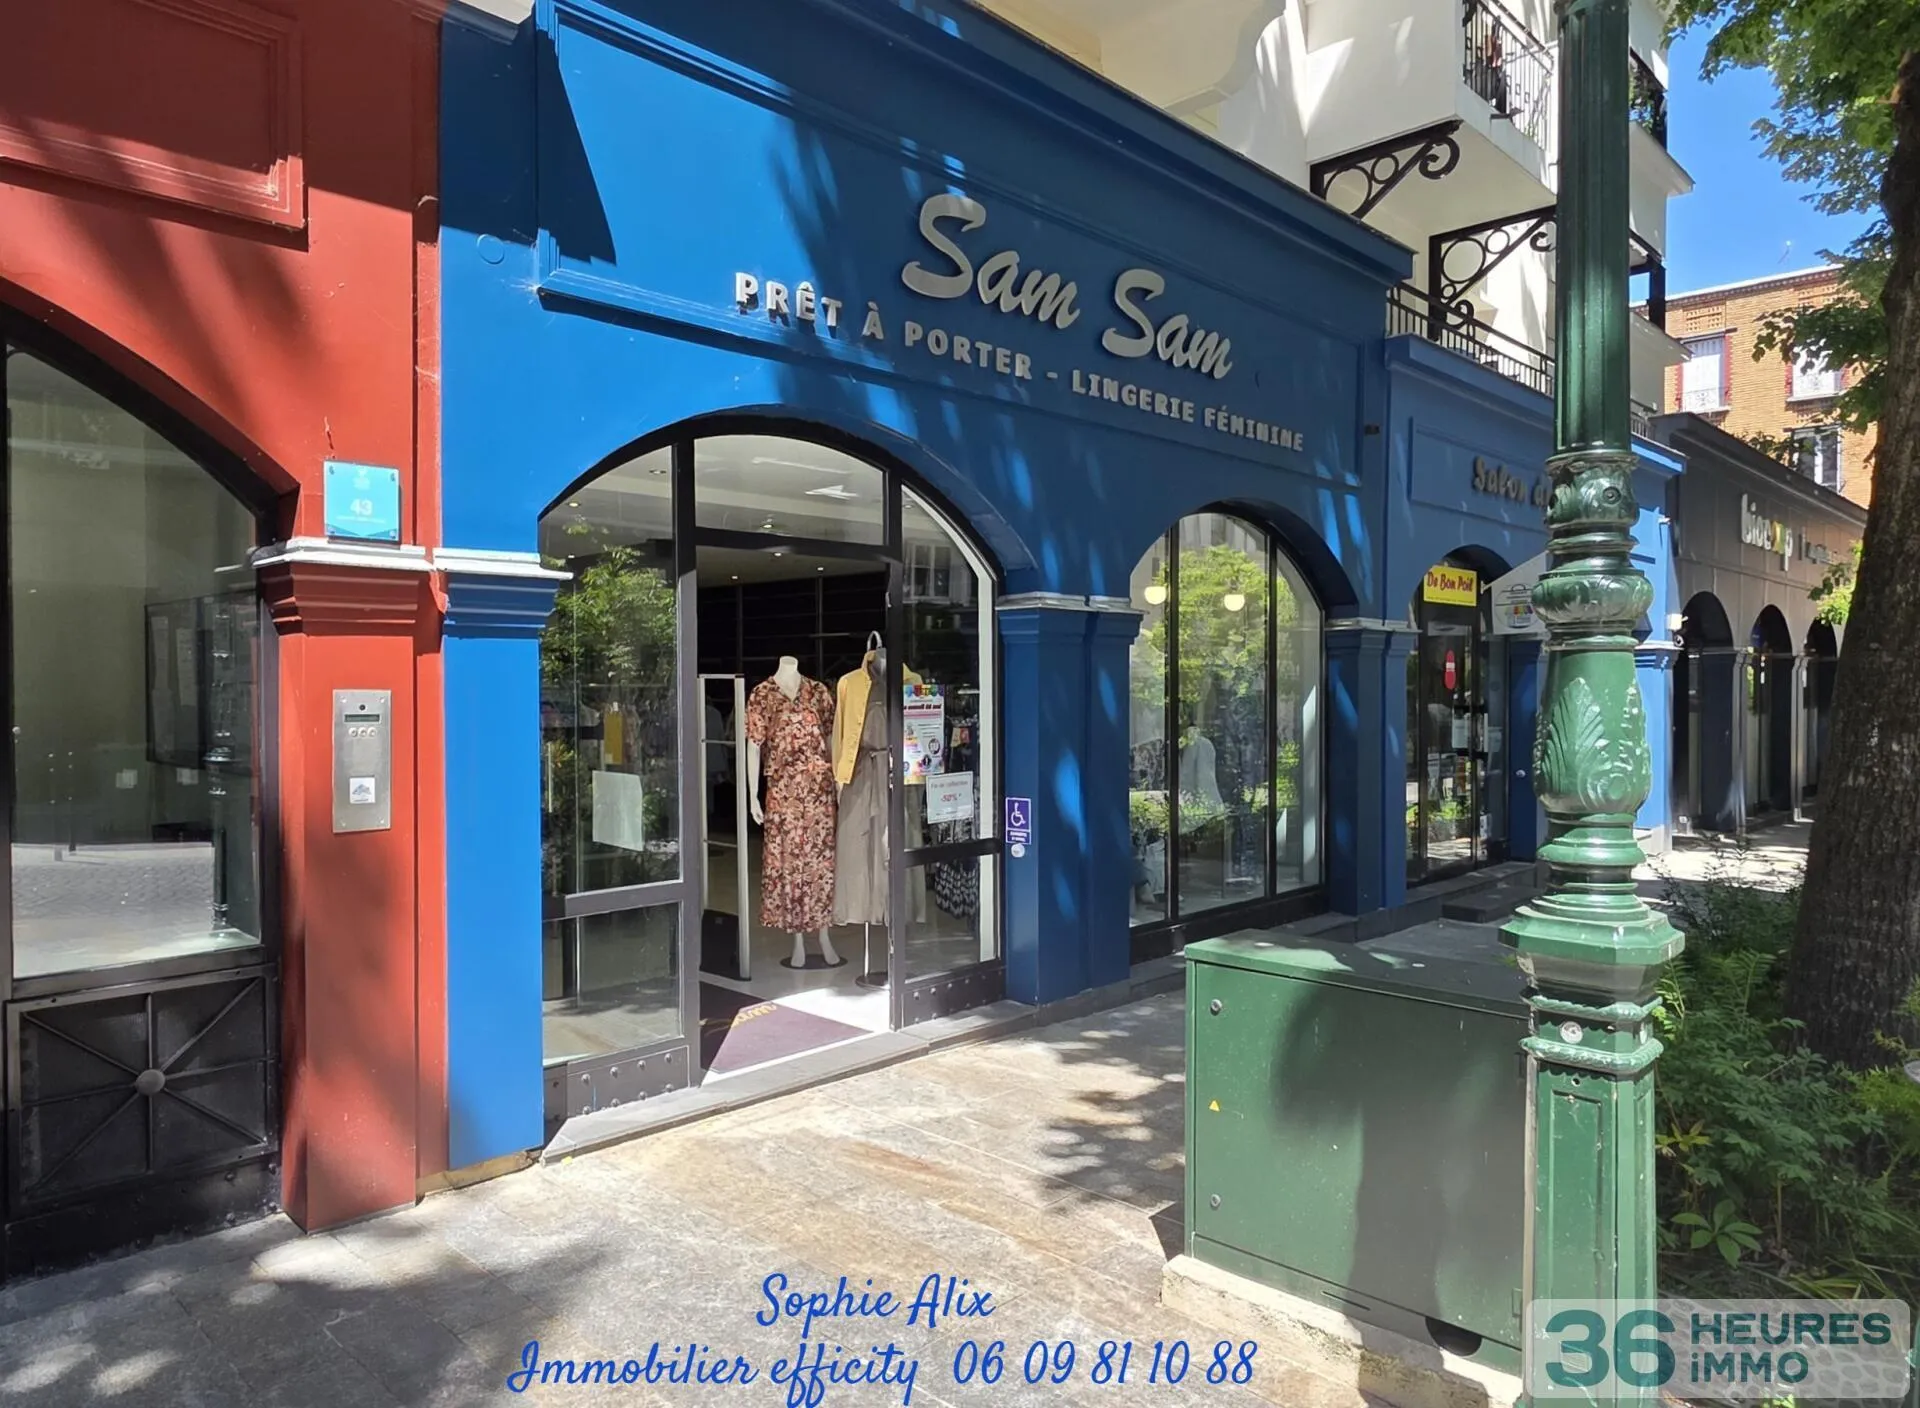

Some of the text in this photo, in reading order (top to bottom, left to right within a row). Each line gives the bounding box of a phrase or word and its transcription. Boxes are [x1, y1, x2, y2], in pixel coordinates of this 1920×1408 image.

[901, 194, 1233, 380] Sam Sam
[735, 272, 842, 328] PRÊT
[862, 301, 885, 341] À
[905, 320, 1033, 381] PORTER
[1072, 369, 1195, 424] LINGERIE
[1203, 404, 1304, 452] FÉMININE
[1472, 455, 1527, 503] Salon
[349, 498, 373, 516] 43
[1427, 571, 1439, 588] De
[1440, 573, 1457, 591] Bon
